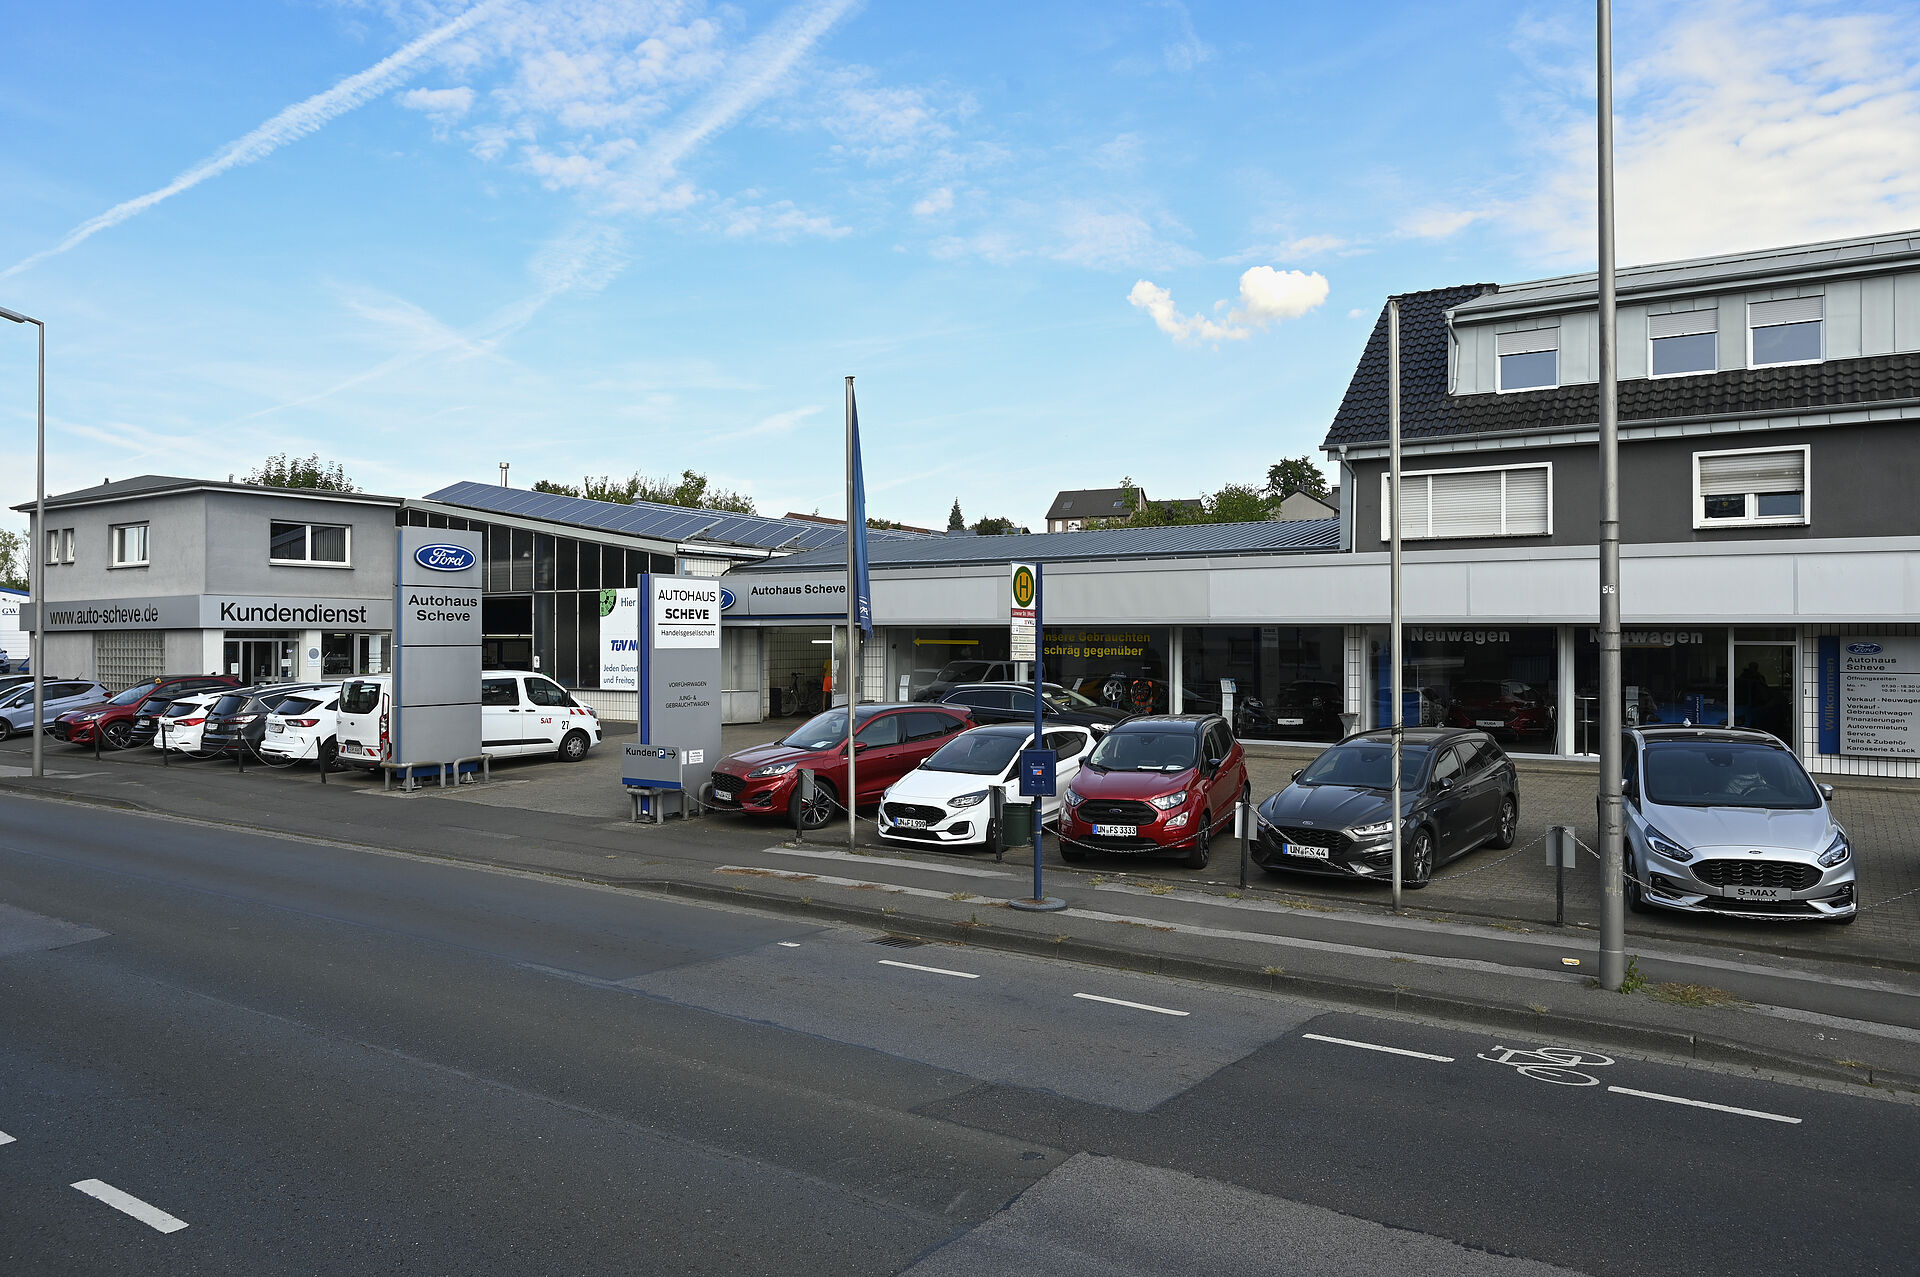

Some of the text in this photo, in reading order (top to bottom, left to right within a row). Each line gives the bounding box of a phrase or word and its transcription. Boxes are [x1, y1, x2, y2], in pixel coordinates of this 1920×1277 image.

[428, 548, 465, 566] Ford
[751, 584, 846, 596] Autohaus Scheve
[1020, 576, 1028, 598] H
[408, 594, 478, 606] Autohaus
[658, 590, 716, 602] AUTOHAUS
[620, 598, 636, 607] Hier
[50, 603, 159, 624] www.auto-scheve.de
[220, 602, 367, 623] Kundendienst
[416, 610, 470, 622] Scheve
[665, 608, 710, 620] SCHEVE
[1078, 632, 1151, 642] Gebrauchten
[1410, 627, 1510, 644] Neuwagen
[1589, 628, 1702, 646] Nuwagen
[1044, 645, 1080, 658] schräg
[1084, 646, 1144, 658] gegenüber
[616, 676, 635, 686] Freitag
[1824, 658, 1835, 731] Willkommen
[562, 720, 569, 730] 27
[626, 747, 665, 758] Kunden P
[1316, 849, 1326, 857] 44
[1738, 888, 1777, 897] S-MAX
